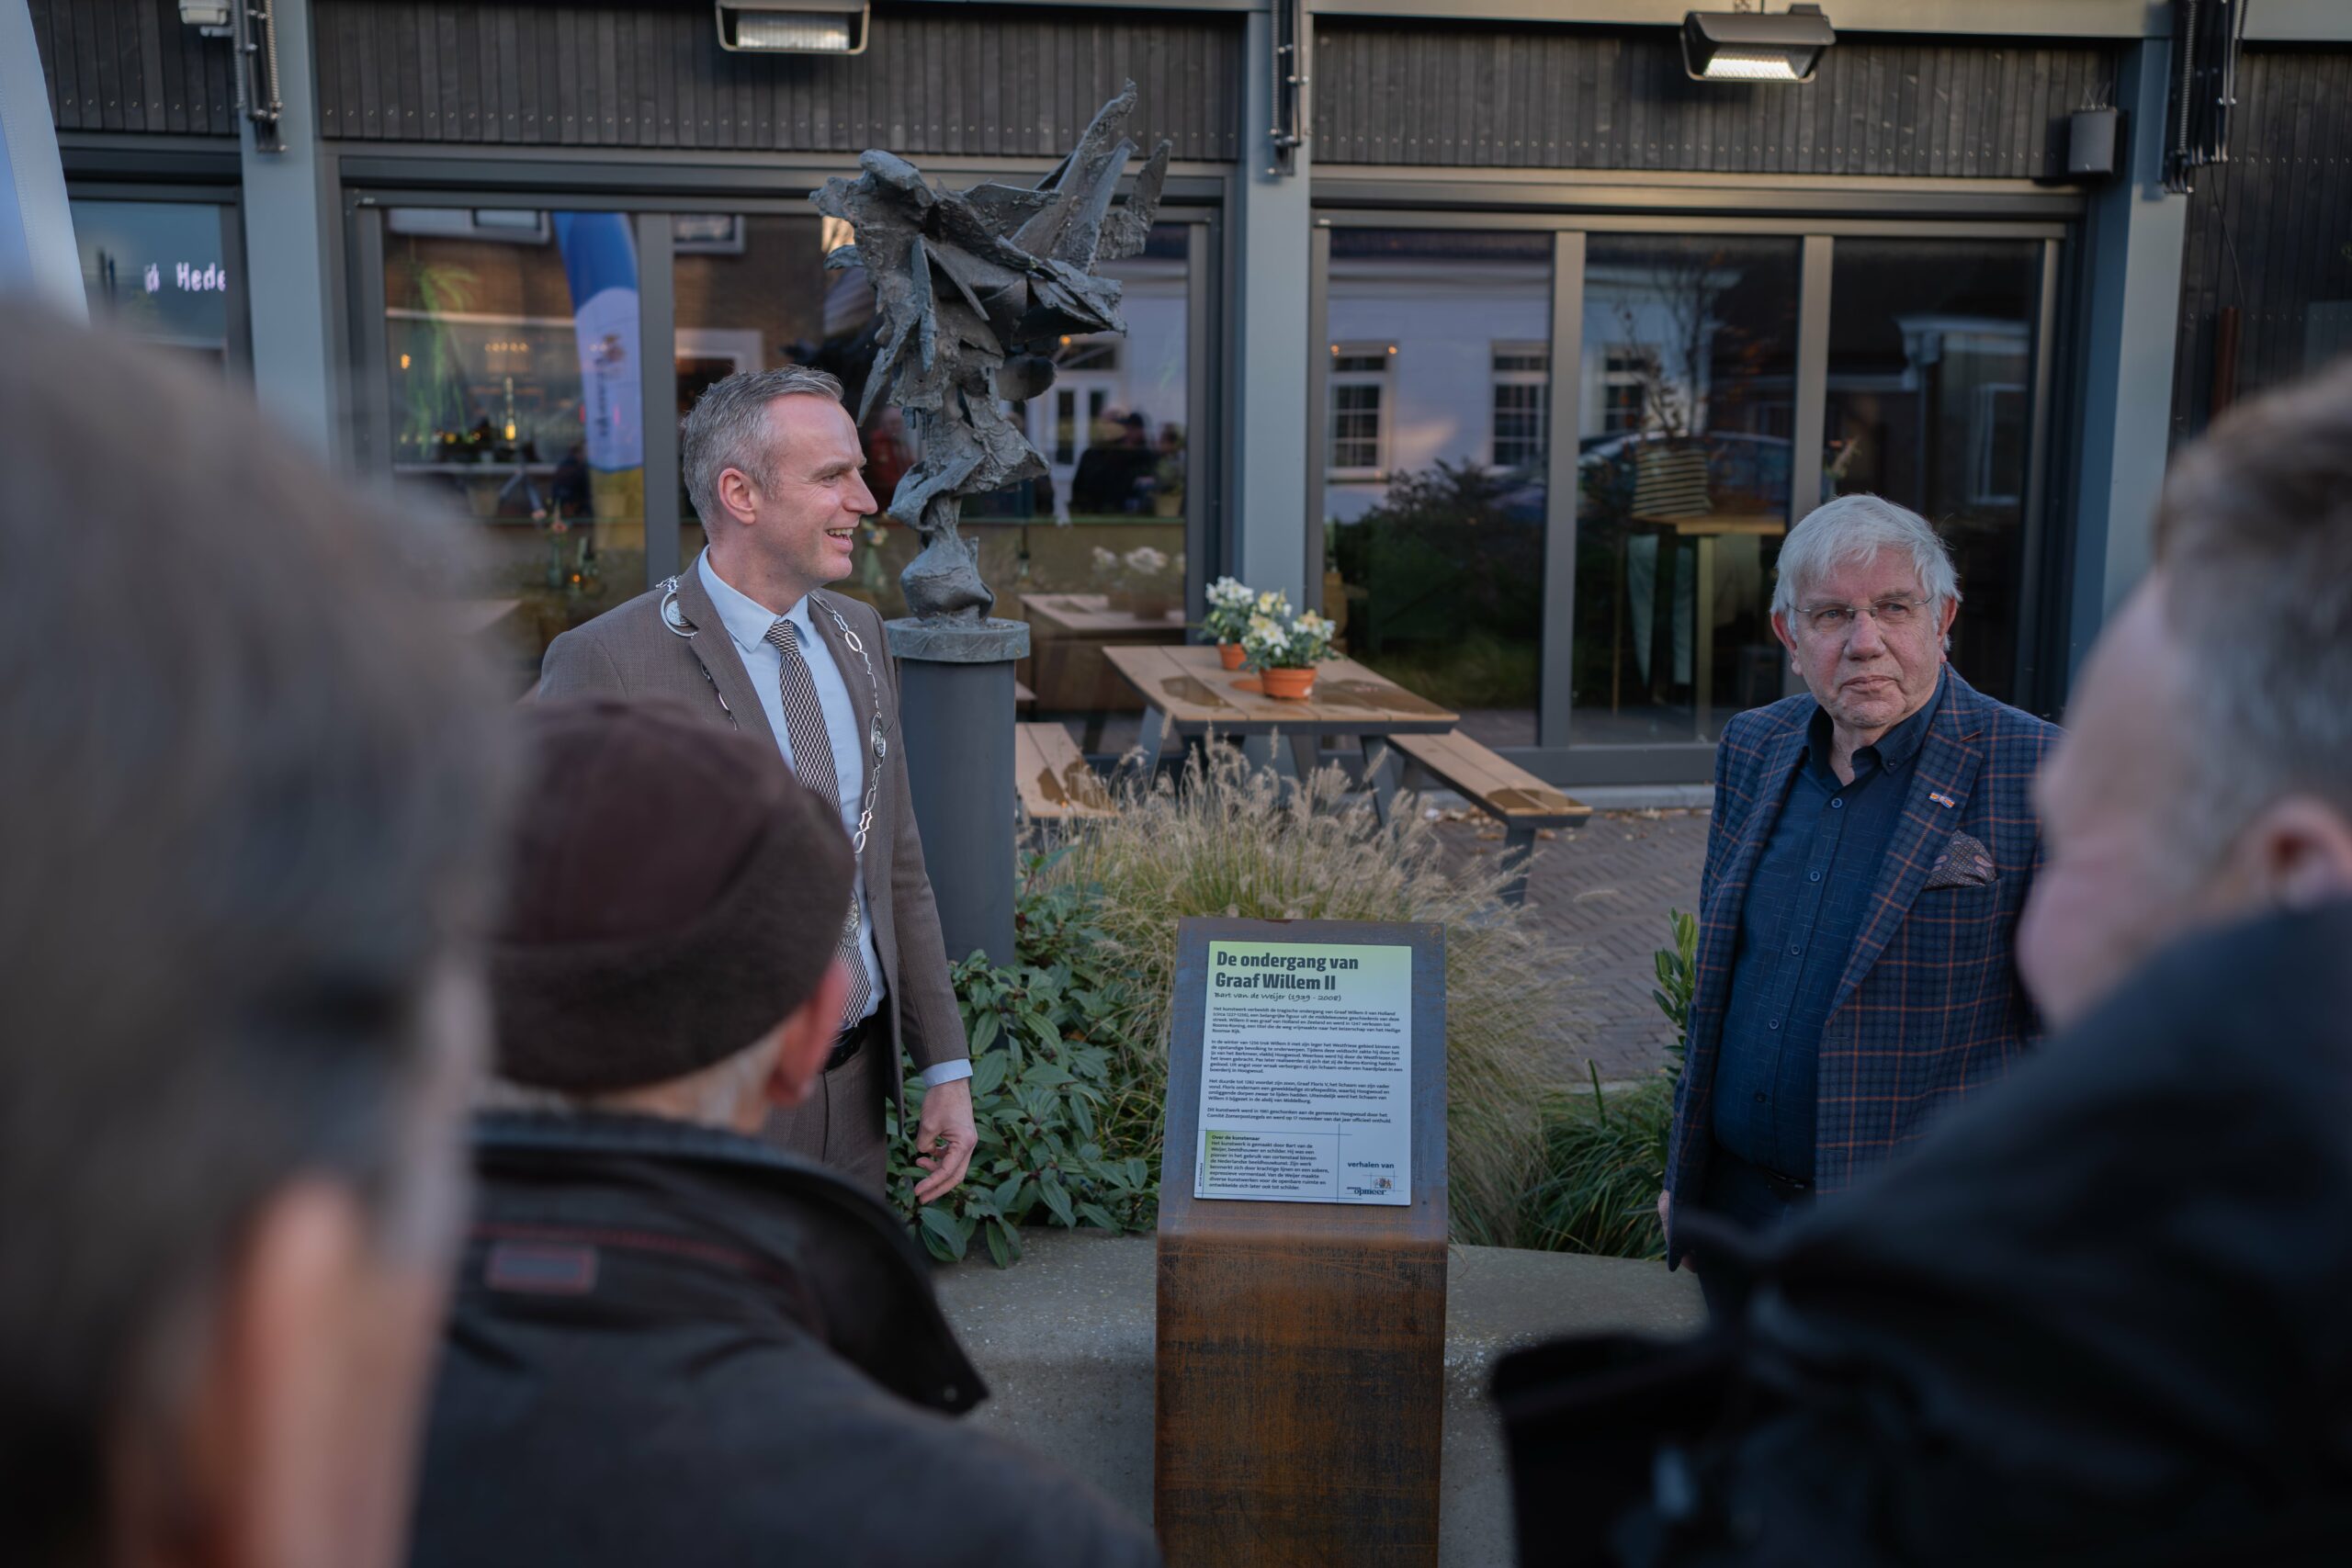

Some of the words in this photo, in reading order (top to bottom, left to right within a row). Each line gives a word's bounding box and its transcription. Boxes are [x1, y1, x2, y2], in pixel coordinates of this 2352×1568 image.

[1216, 951, 1237, 966] De
[1240, 953, 1326, 972] ondergang
[1329, 958, 1359, 969] van
[1216, 972, 1261, 988] Graaf
[1262, 974, 1320, 990] Willem
[1324, 976, 1336, 990] II
[1261, 993, 1286, 1001] Weijer
